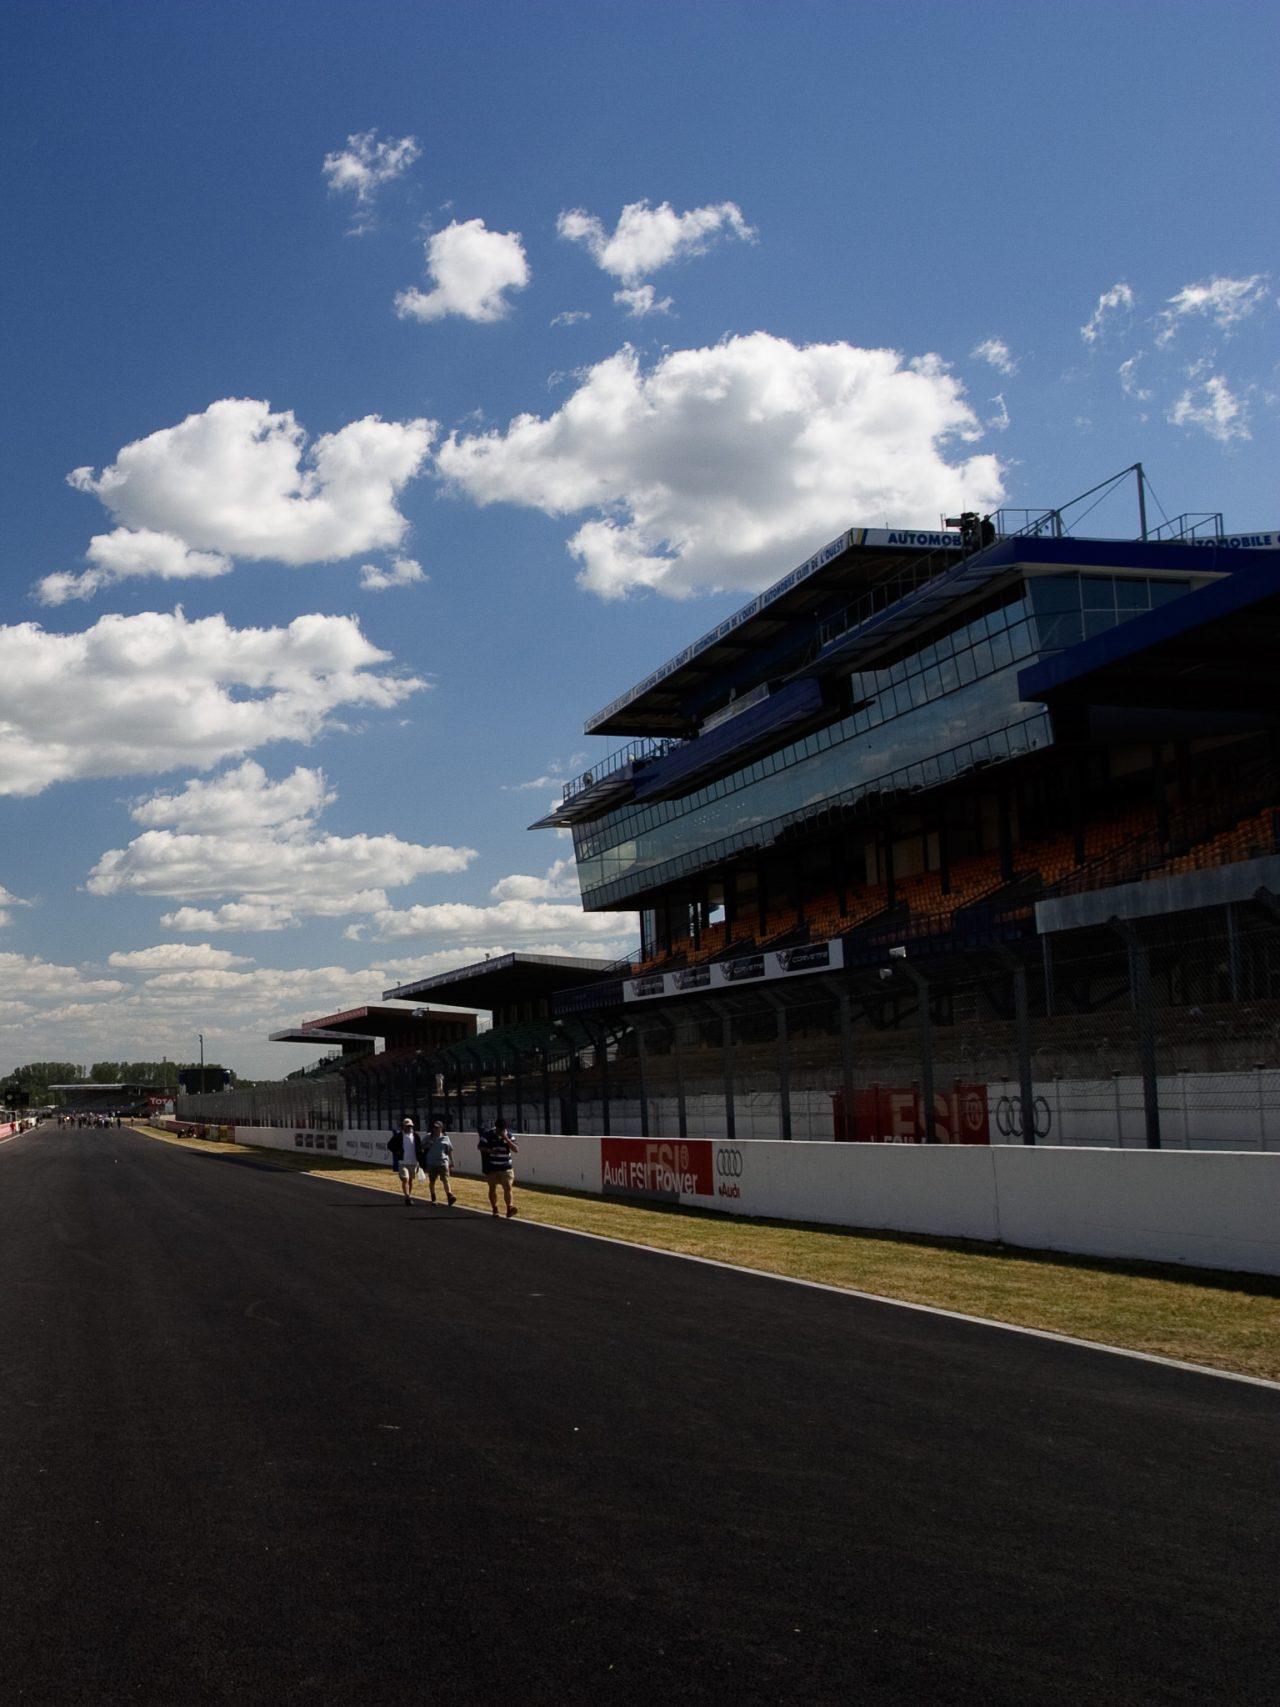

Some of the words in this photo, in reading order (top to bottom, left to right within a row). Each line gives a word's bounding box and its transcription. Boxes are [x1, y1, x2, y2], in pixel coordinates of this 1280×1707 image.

[603, 1160, 628, 1188] Audi
[630, 1162, 648, 1189] FSI
[656, 1163, 699, 1195] Power
